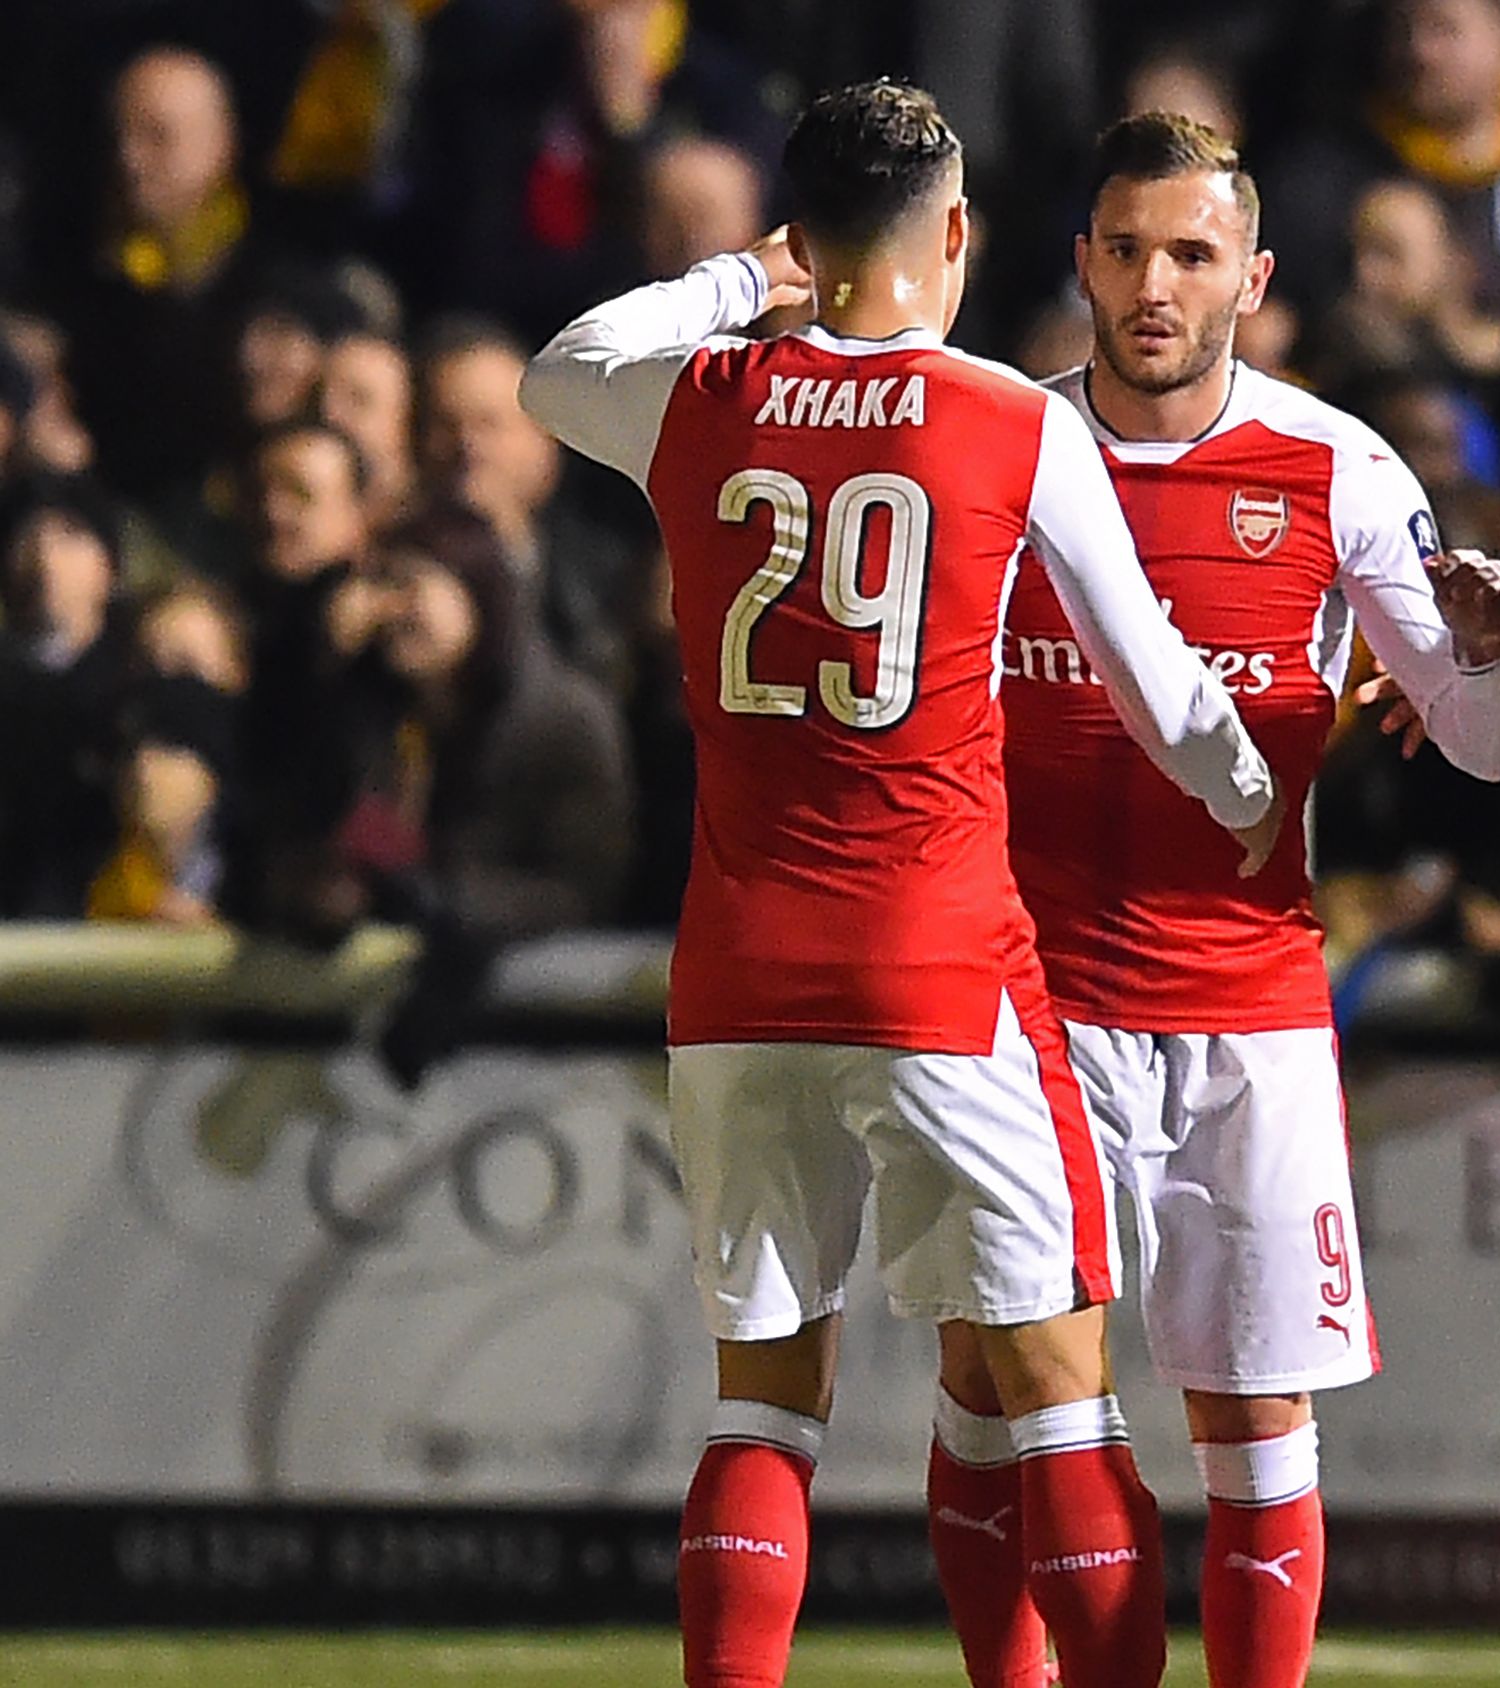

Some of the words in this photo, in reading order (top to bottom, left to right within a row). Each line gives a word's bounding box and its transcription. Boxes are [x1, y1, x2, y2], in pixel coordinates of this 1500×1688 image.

[754, 374, 926, 428] XHAKA
[716, 467, 931, 730] 29
[1313, 1202, 1351, 1308] 9
[681, 1535, 789, 1560] ARSENAL
[1031, 1547, 1143, 1574] ARSENAL
